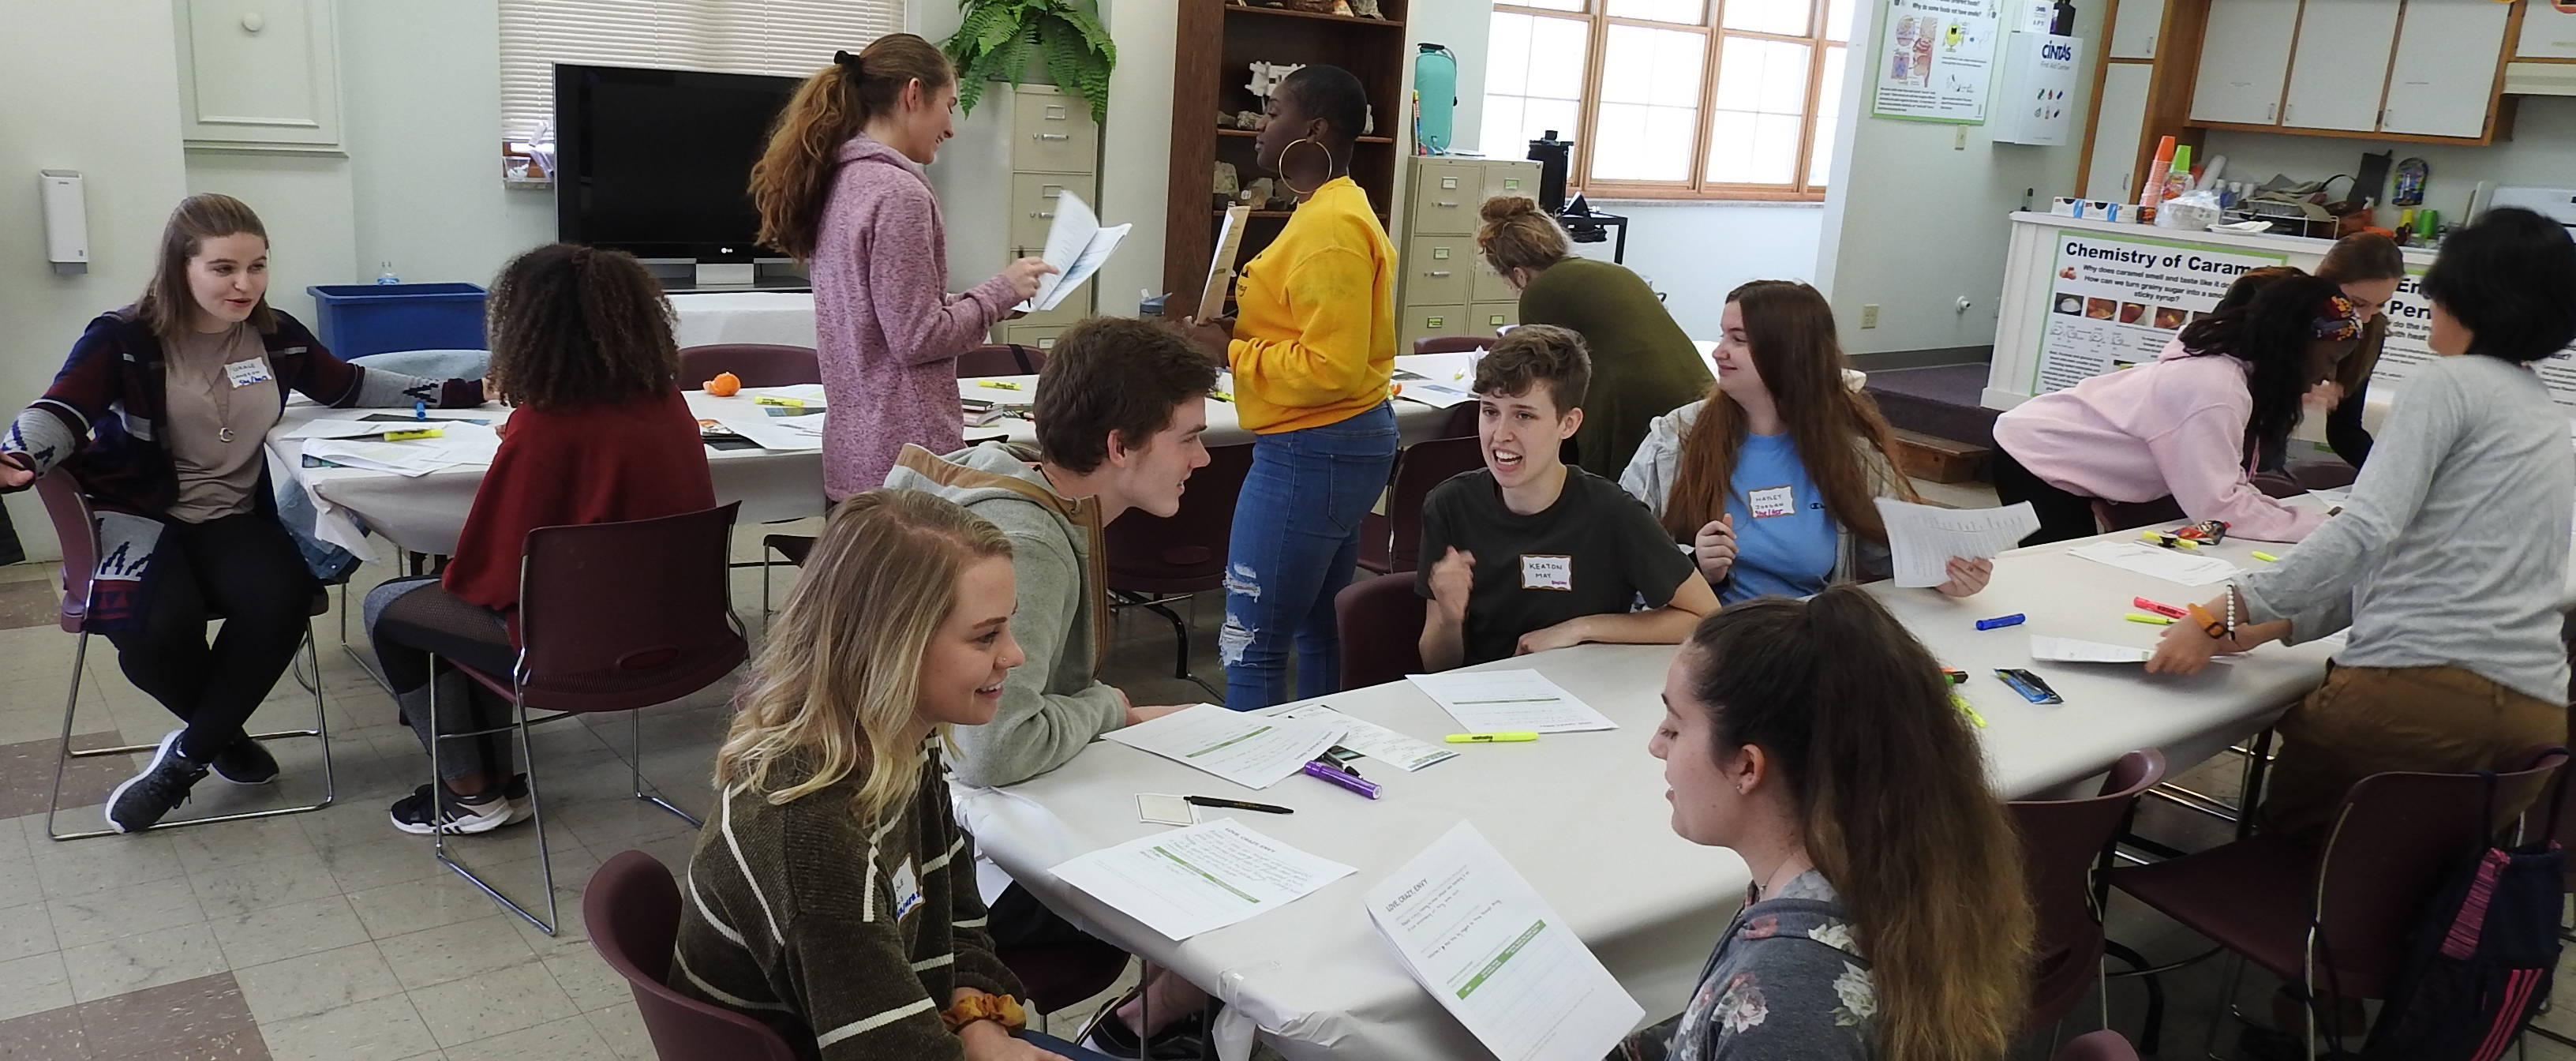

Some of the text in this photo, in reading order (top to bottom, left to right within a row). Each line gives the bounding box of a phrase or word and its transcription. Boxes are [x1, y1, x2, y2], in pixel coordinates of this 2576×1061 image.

[2066, 242, 2252, 276] Chemistry of Caram
[2180, 276, 2198, 285] taste
[2141, 283, 2162, 292] grainy
[2134, 291, 2154, 300] sticky
[1413, 878, 1428, 892] ENVY
